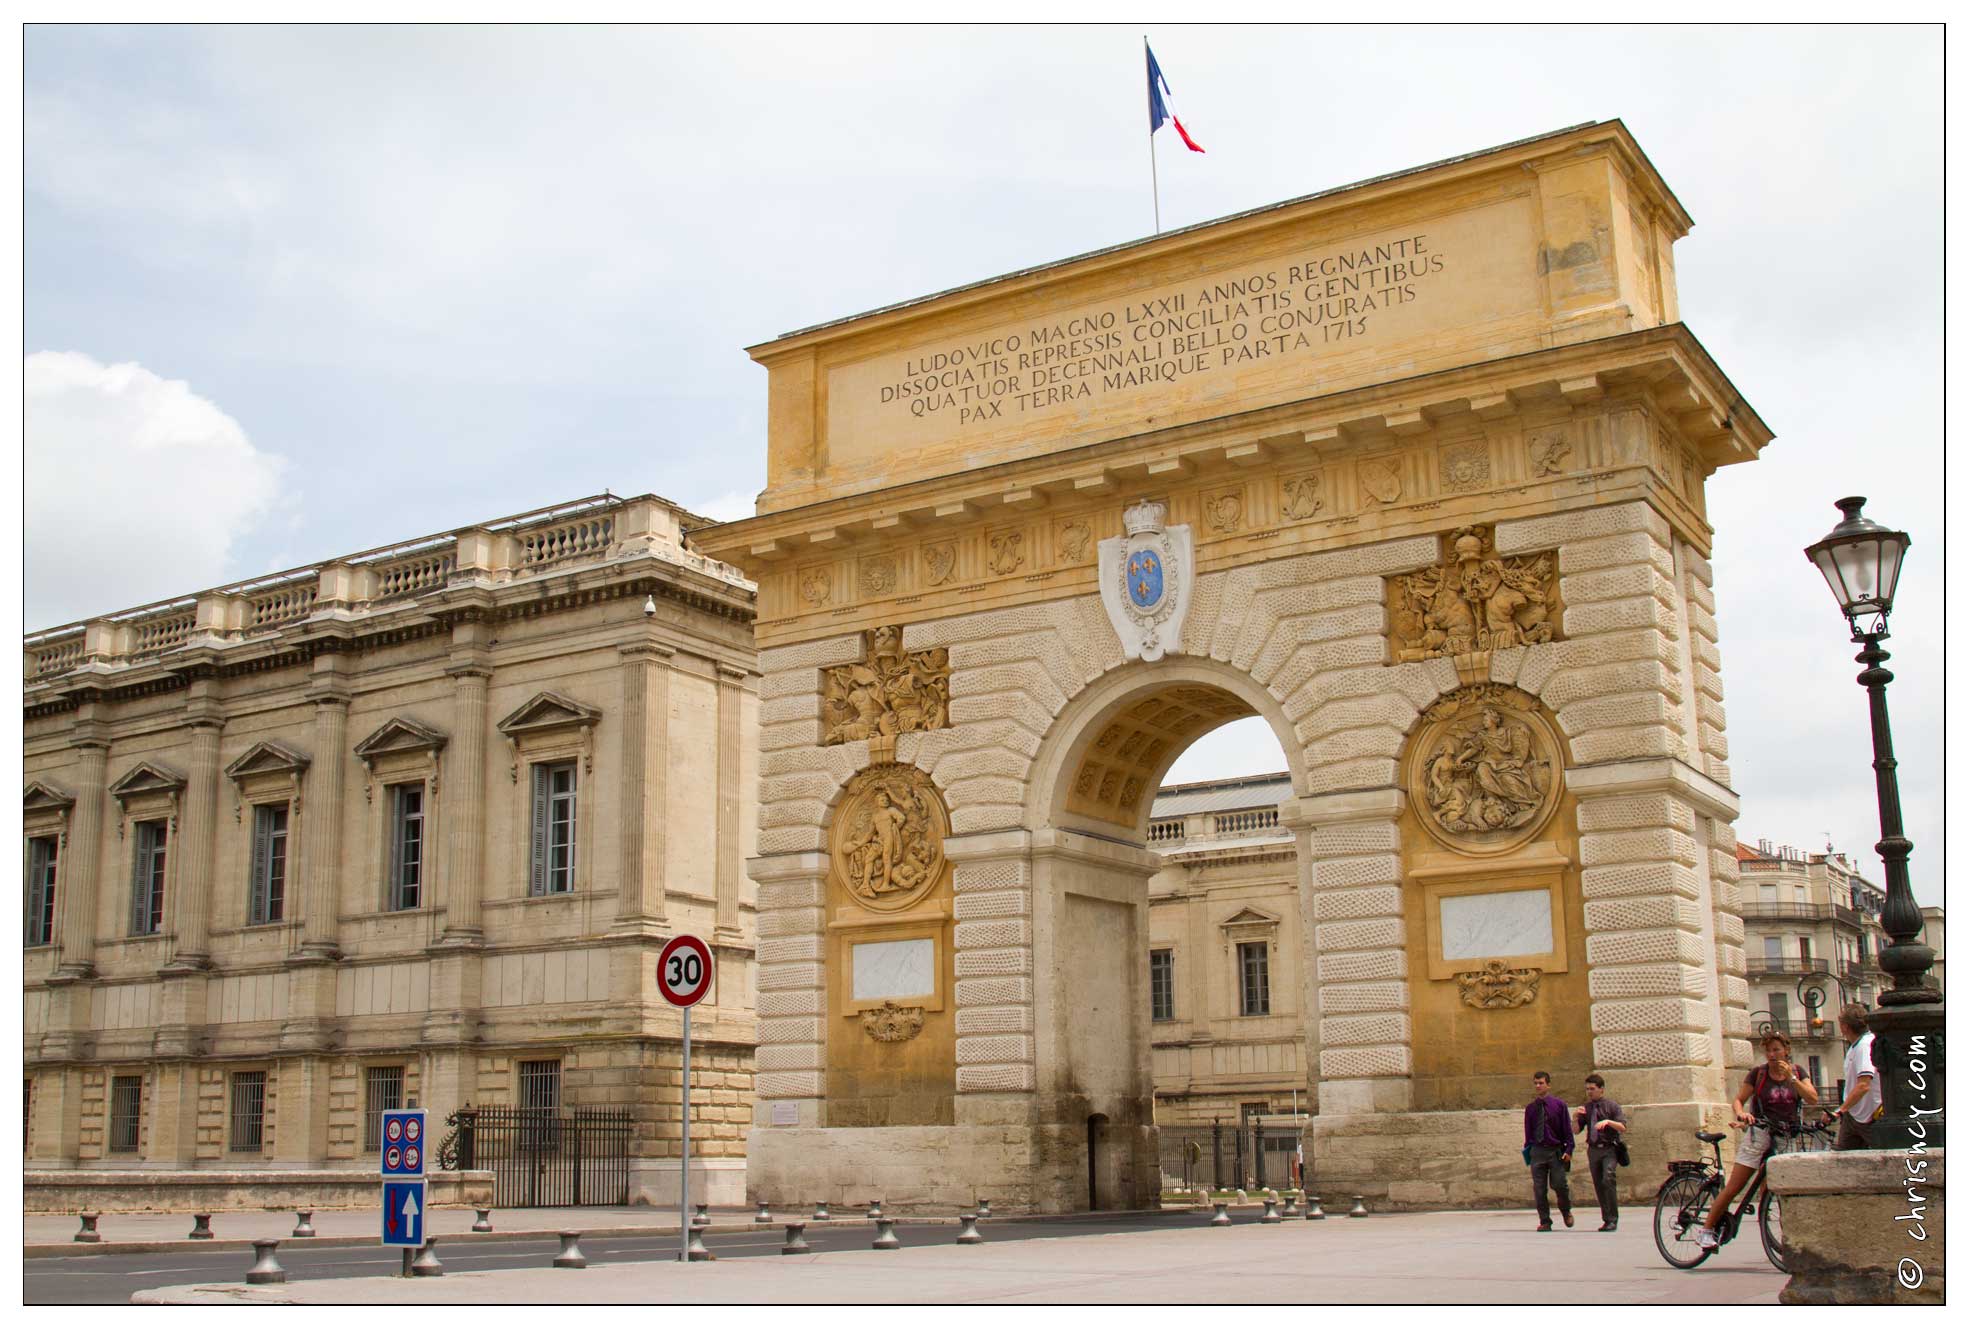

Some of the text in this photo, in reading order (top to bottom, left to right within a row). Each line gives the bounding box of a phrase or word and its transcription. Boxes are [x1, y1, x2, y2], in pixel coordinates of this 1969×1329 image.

[880, 254, 1444, 403] DISSOCIATIS REPRESSIS CONCILIATIS GENTIBUS
[907, 234, 1428, 377] LUDOVICO MAGNO LXXII ANNOS REGNANTE
[911, 283, 1416, 417] QUATUOR DECENNALI BELLO CONJURATIS
[960, 316, 1368, 425] PAX TERRA MARIQUE PARTA 1715
[667, 954, 702, 987] 30
